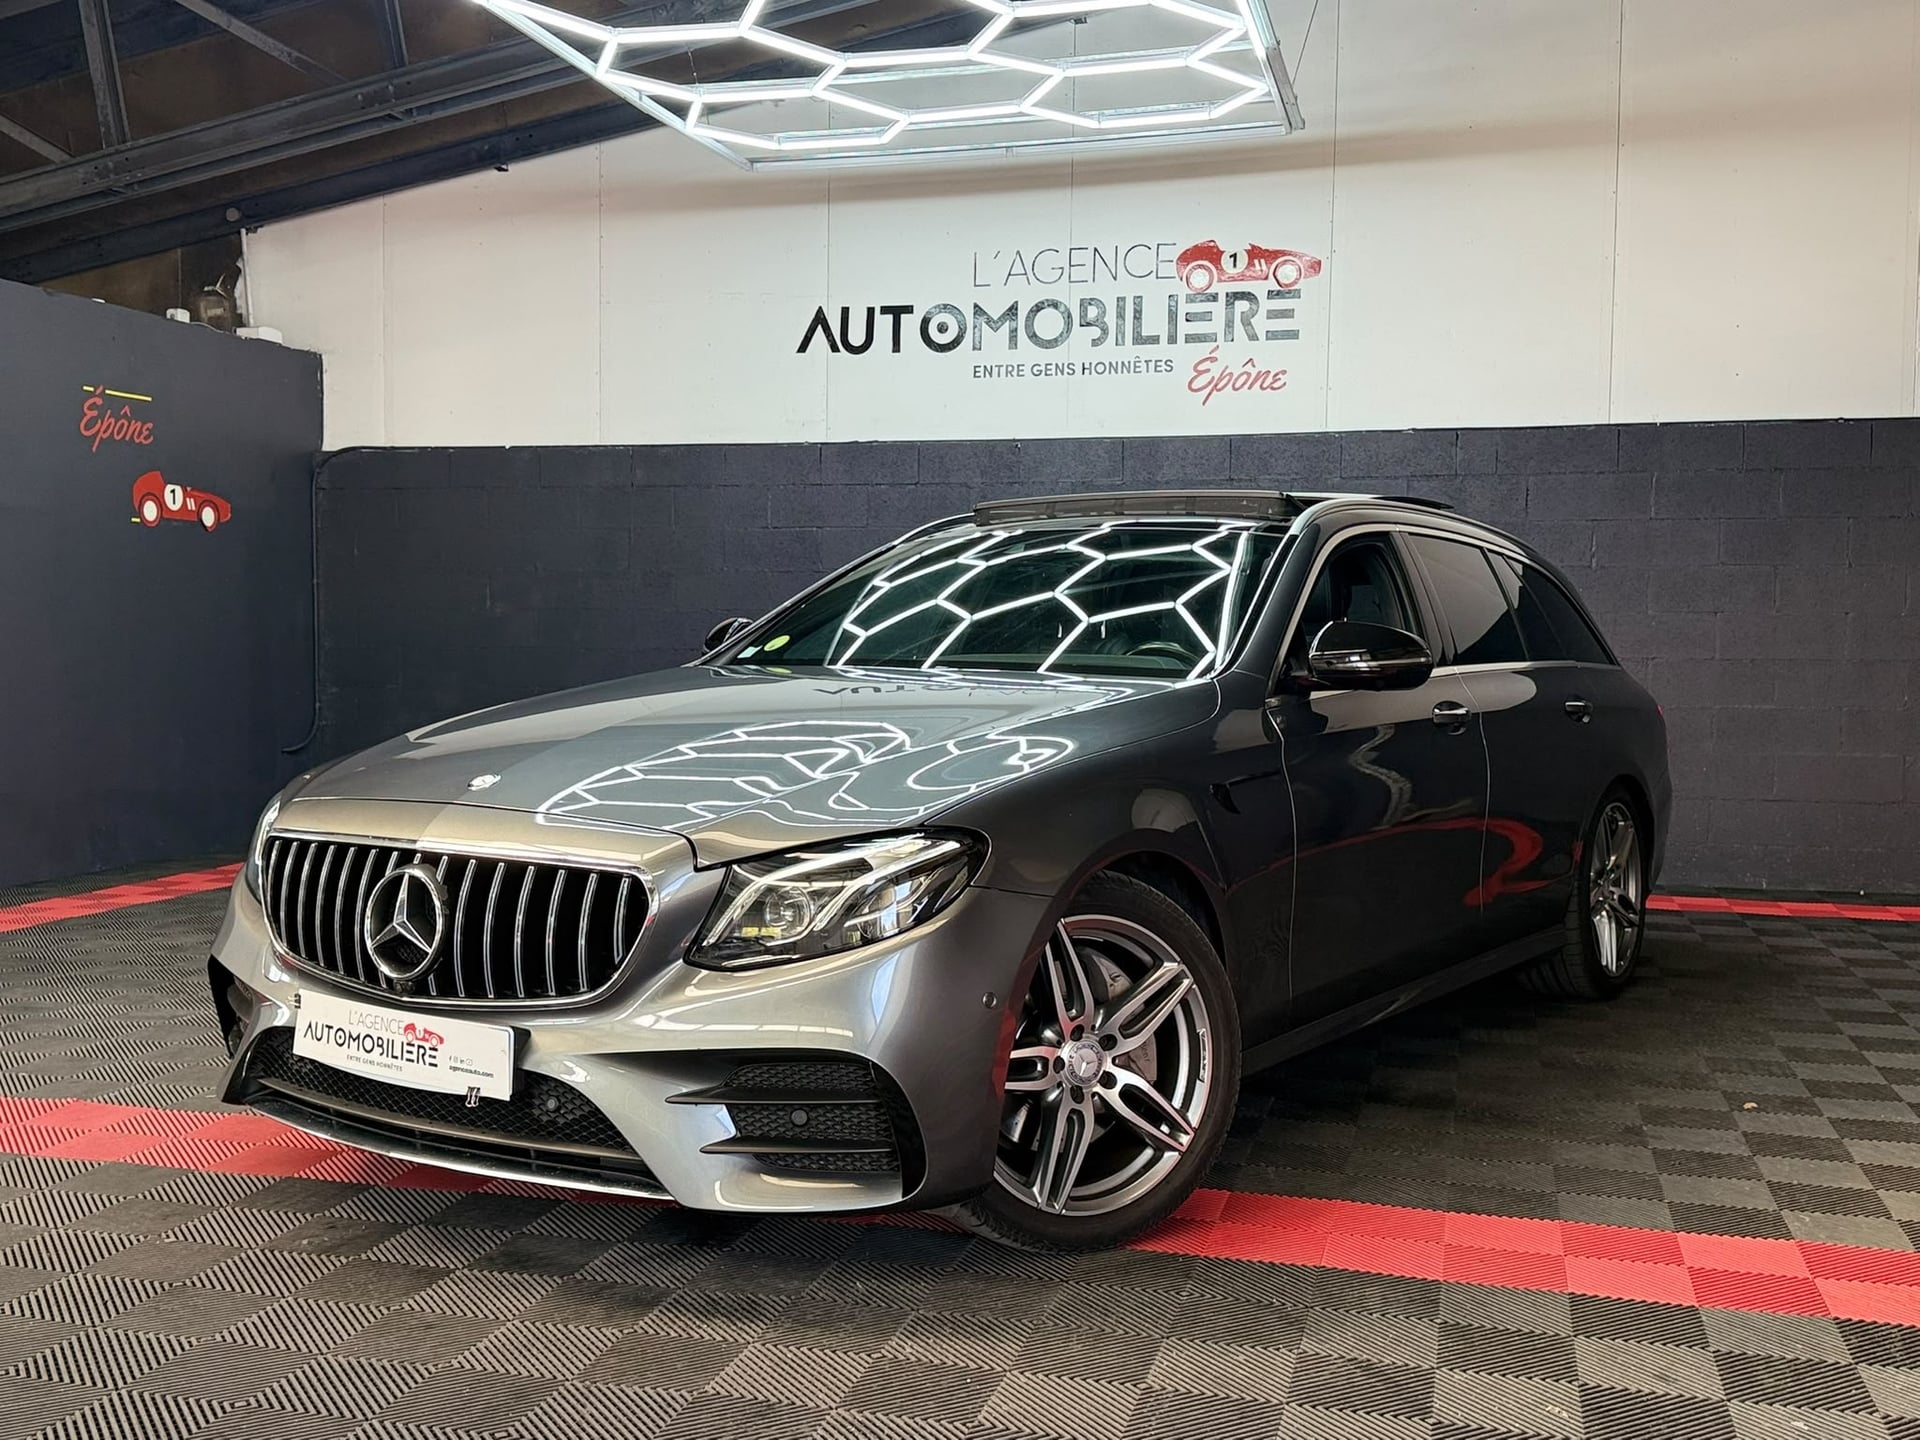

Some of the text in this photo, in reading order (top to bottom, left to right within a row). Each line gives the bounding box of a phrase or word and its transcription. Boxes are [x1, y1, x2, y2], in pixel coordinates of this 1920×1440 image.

[972, 242, 1177, 288] L'AGENCE
[1228, 252, 1238, 269] 1
[972, 355, 1174, 379] ENTRE GENS HONNÊTES
[169, 488, 177, 505] 1
